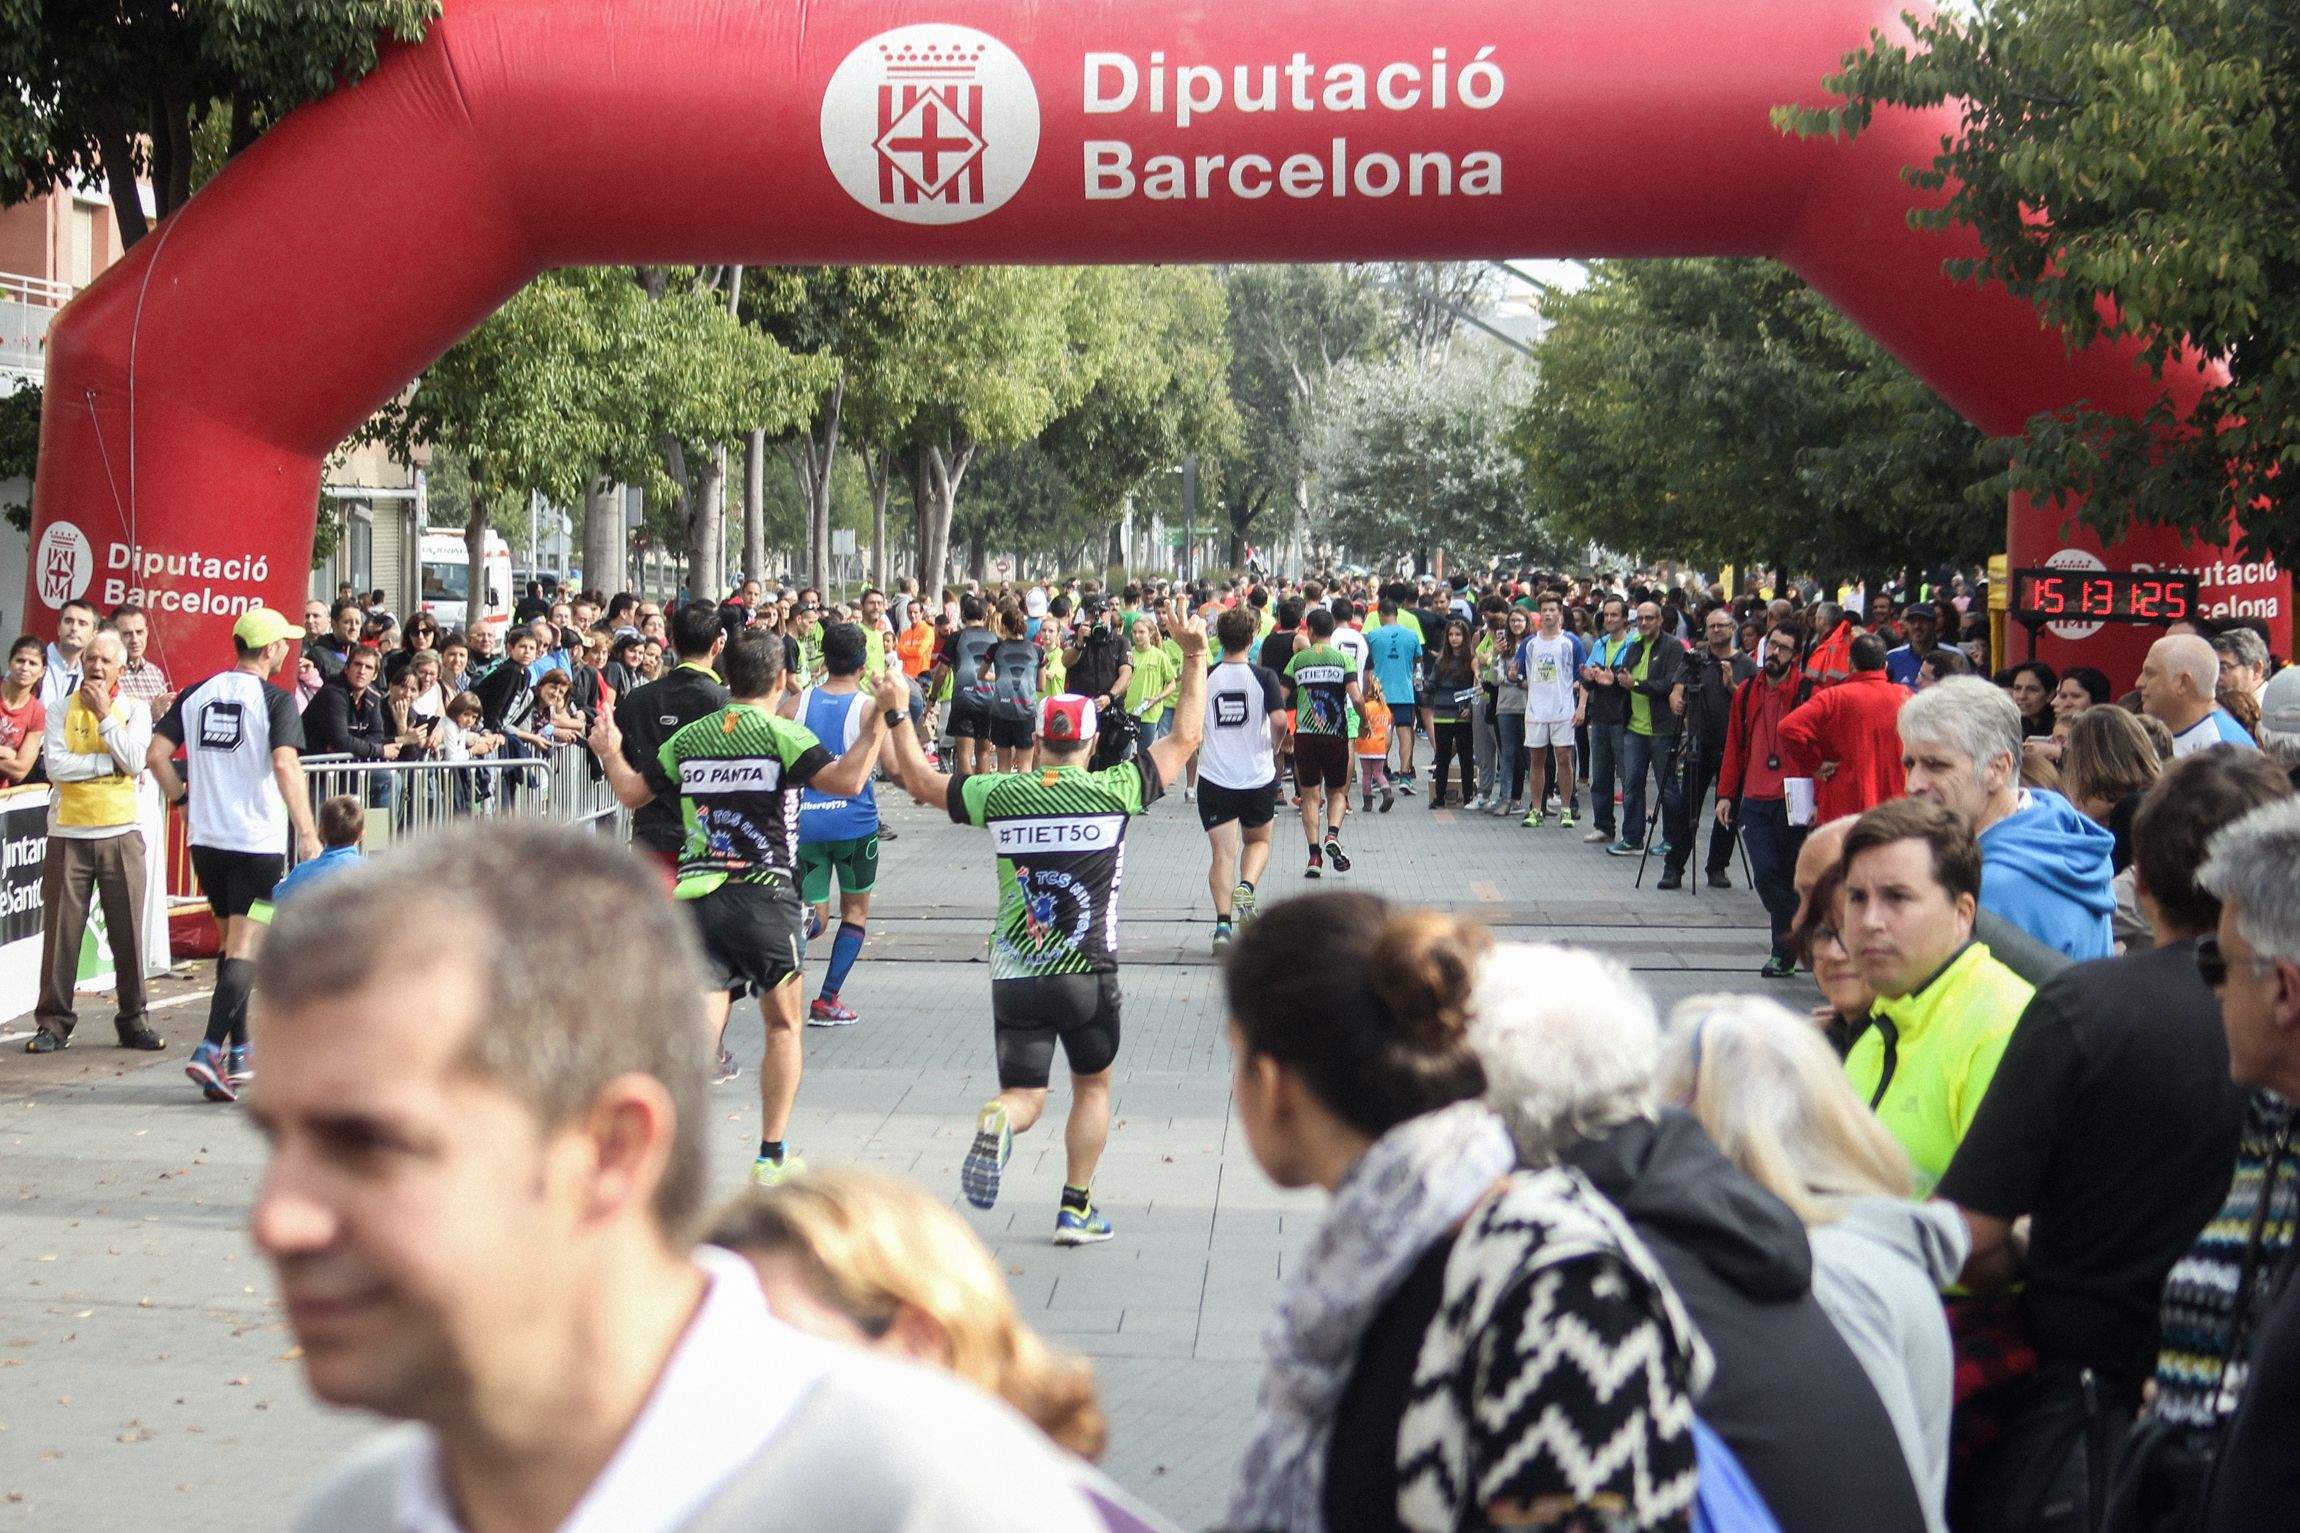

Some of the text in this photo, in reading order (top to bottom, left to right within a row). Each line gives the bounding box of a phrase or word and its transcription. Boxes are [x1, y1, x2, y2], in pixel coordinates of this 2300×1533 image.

[1083, 45, 1505, 128] Diputació
[1083, 137, 1503, 201] Barcelona
[107, 542, 269, 583] Diputació
[710, 767, 764, 784] PANTA
[1000, 824, 1101, 844] #TIET50
[1034, 870, 1072, 888] TCS
